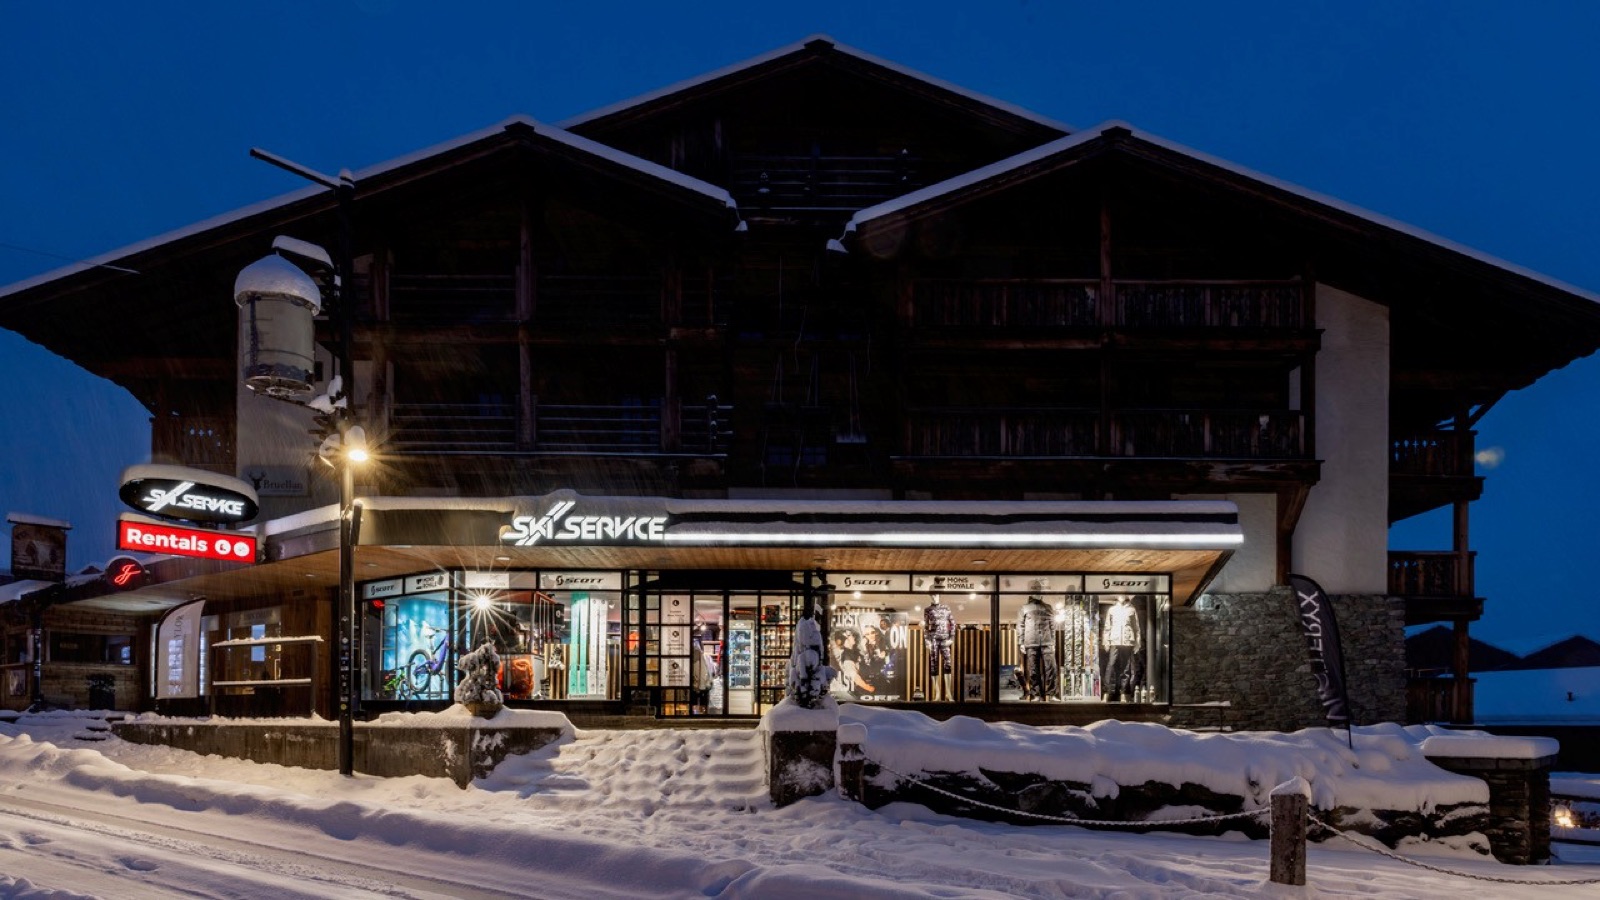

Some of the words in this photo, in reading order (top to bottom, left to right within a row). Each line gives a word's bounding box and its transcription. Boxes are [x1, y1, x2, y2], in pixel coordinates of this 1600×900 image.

[142, 481, 195, 512] SKI
[176, 494, 245, 516] SERVICE
[501, 500, 576, 546] SKI
[554, 516, 668, 541] SERVICE
[126, 528, 208, 552] Rentals
[890, 624, 908, 649] ON
